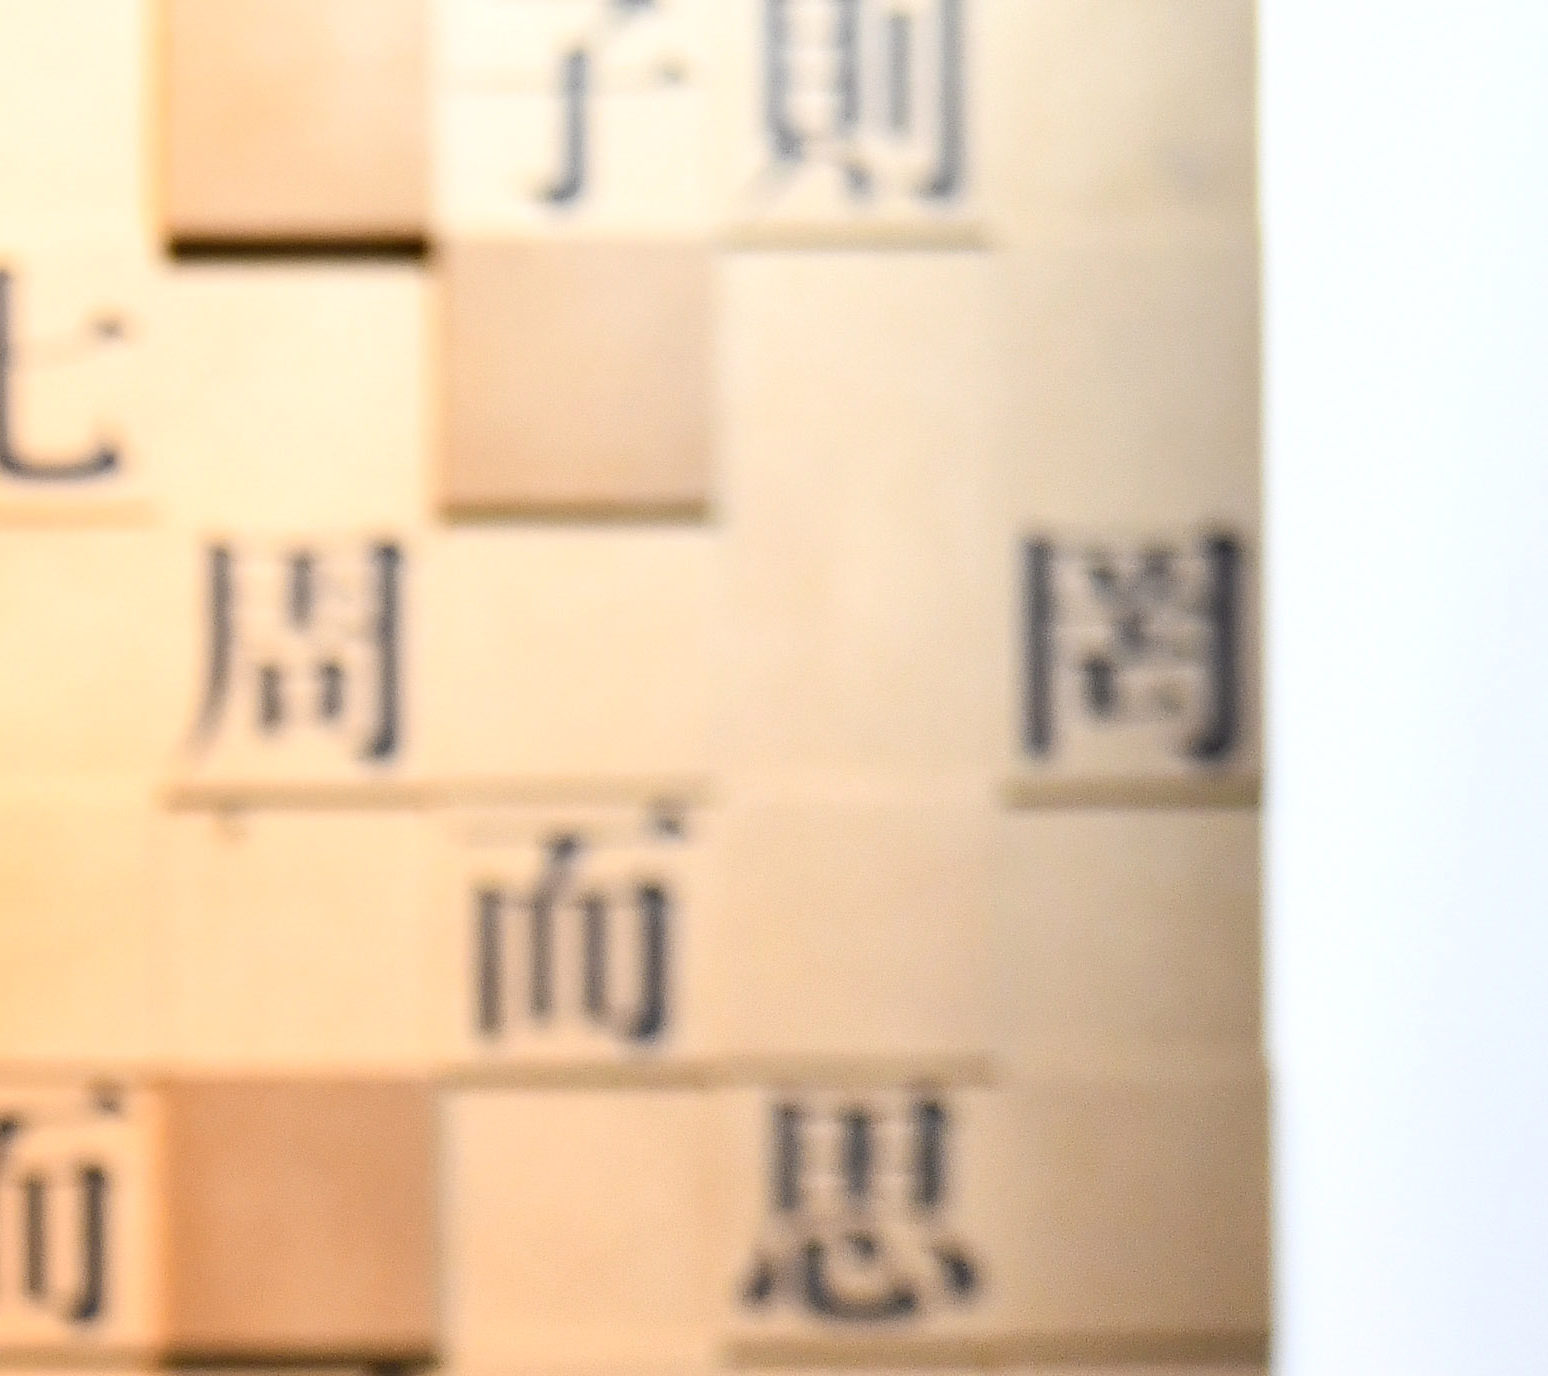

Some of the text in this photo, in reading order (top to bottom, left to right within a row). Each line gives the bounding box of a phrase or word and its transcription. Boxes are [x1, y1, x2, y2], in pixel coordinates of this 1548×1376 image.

[441, 0, 691, 206] 子
[749, 0, 966, 206] 則
[180, 536, 407, 768] 周
[1016, 528, 1246, 762] 罔
[459, 803, 687, 1047] 而
[737, 1090, 984, 1325] 思
